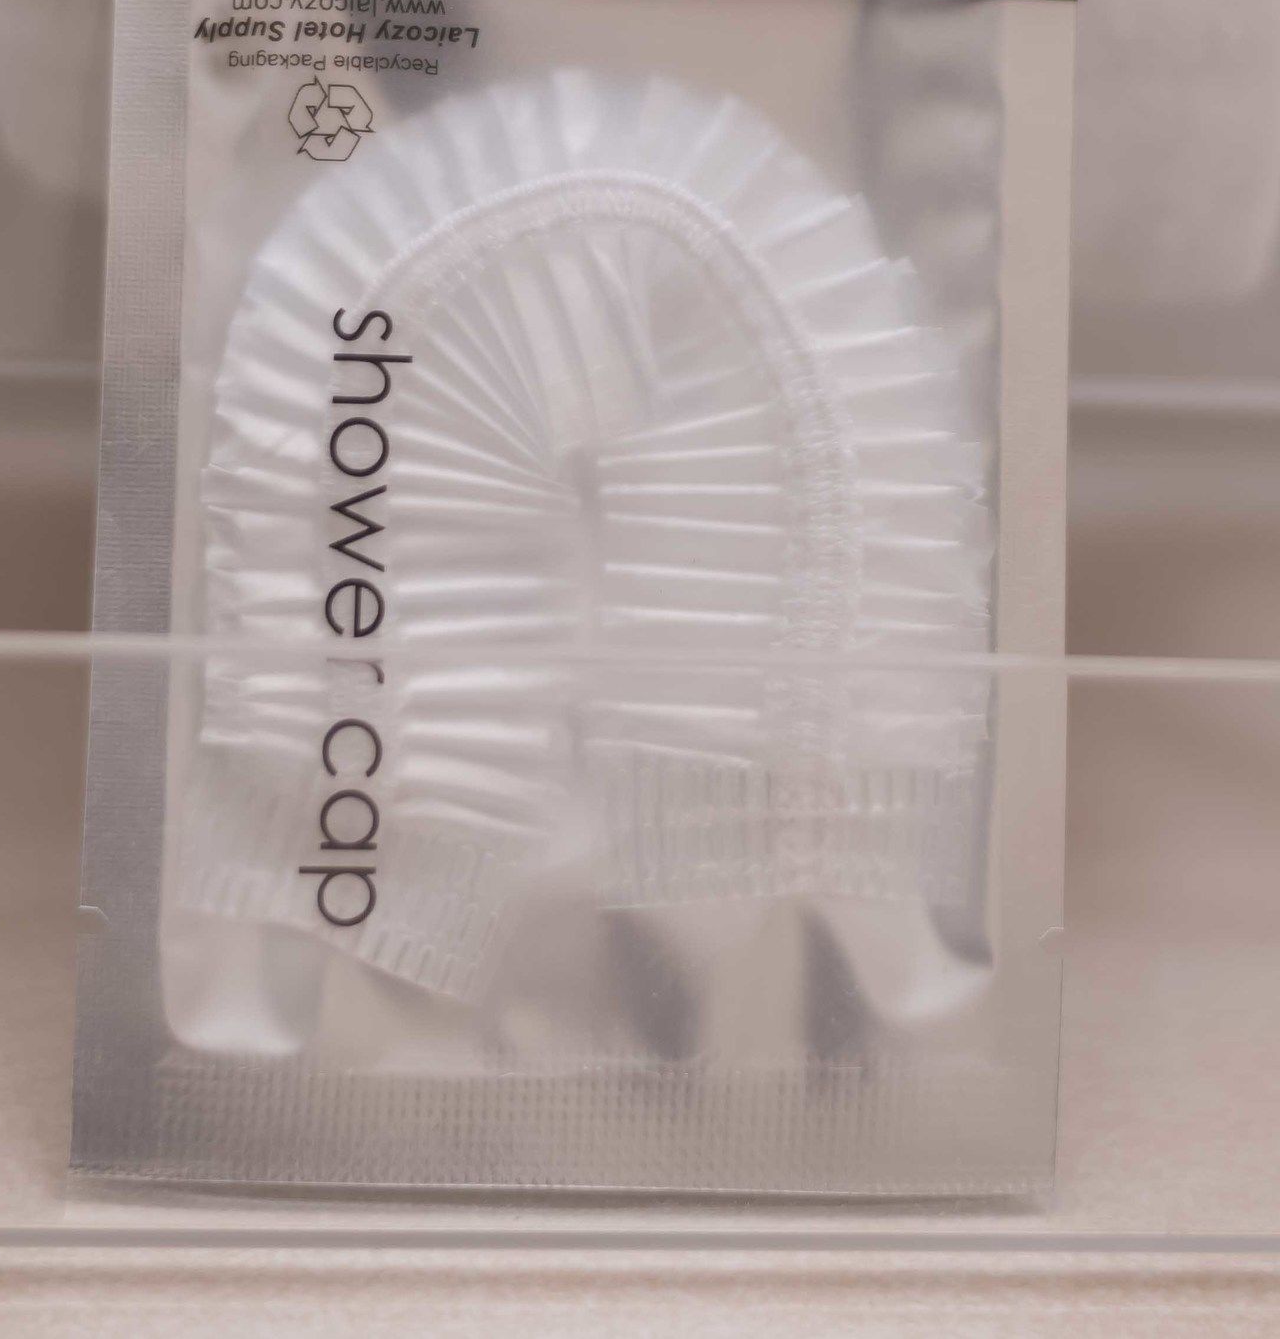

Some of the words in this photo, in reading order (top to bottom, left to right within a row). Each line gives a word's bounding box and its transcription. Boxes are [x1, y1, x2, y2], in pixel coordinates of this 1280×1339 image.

[193, 16, 286, 43] Supply
[294, 20, 368, 45] Hotel
[375, 22, 480, 49] Laicozy
[228, 50, 327, 72] Packaging
[334, 52, 439, 76] Recyclable
